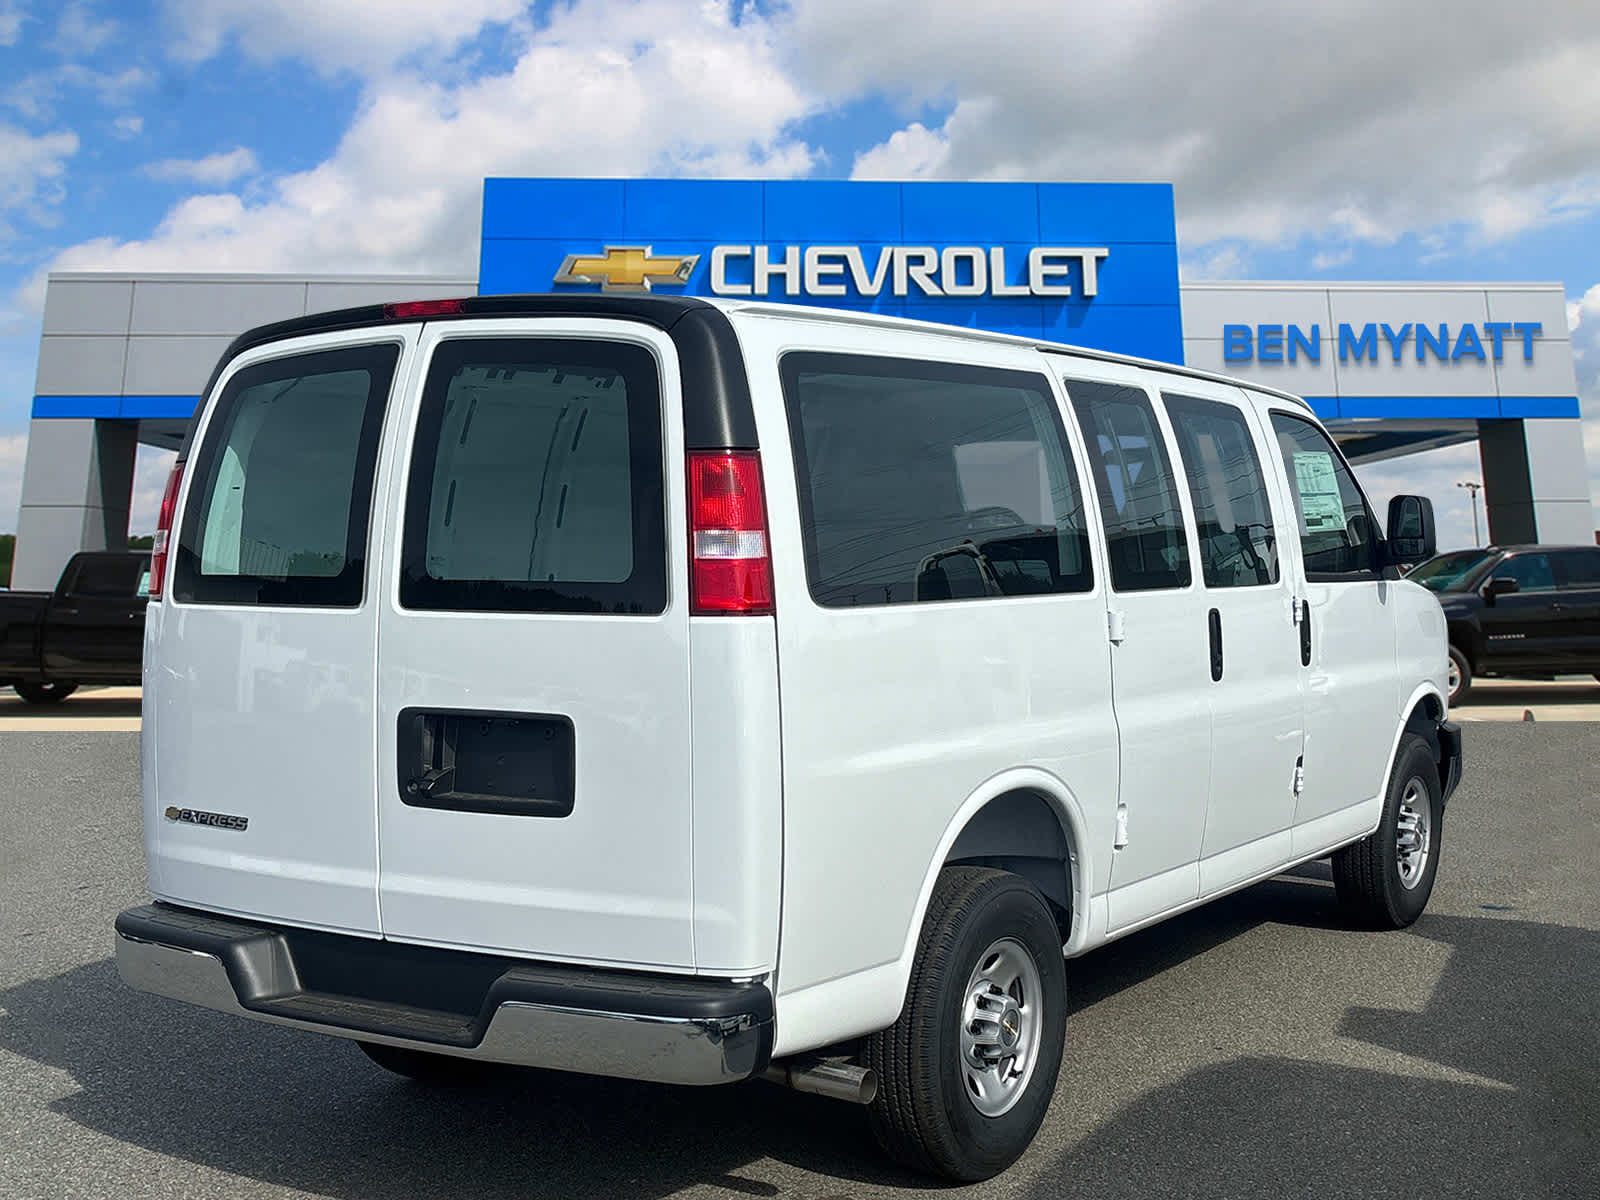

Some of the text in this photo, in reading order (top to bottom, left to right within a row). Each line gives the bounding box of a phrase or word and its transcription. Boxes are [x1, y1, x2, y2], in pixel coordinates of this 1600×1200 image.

[710, 245, 1109, 297] CHEVROLET
[1223, 322, 1543, 362] BEN MYNATT
[179, 808, 248, 831] EXPRESS
